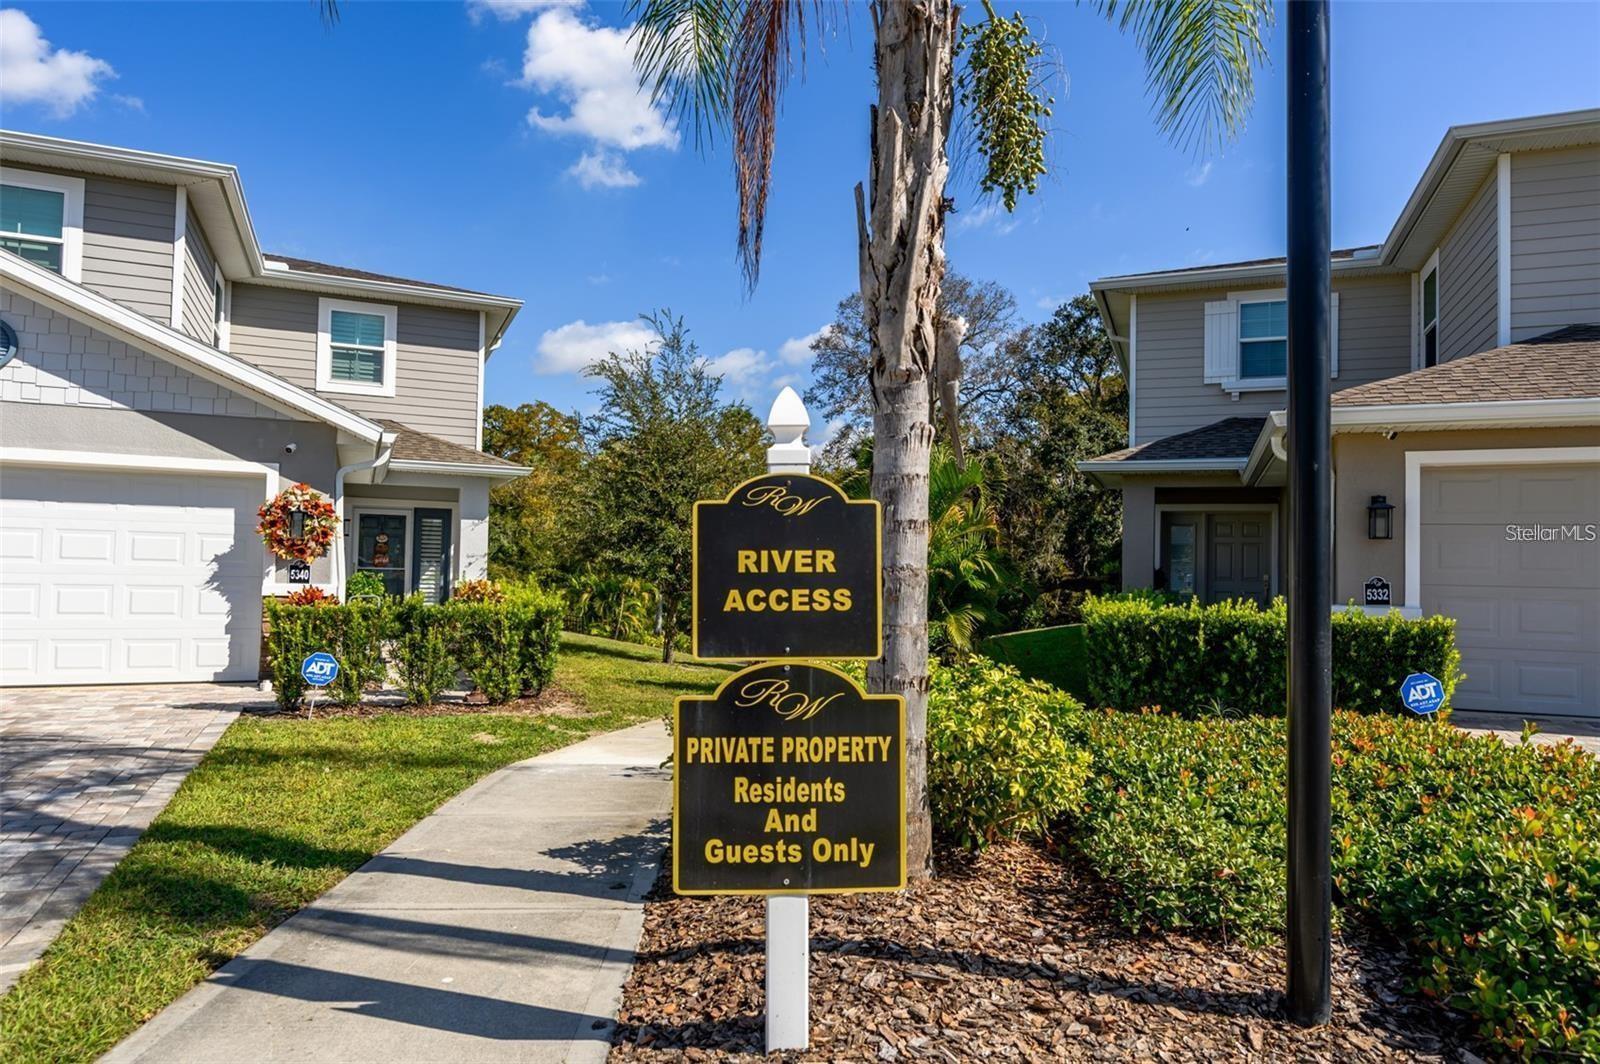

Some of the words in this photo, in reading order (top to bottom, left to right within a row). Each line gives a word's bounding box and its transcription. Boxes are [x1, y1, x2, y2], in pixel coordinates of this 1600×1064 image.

[742, 485, 832, 516] RW
[737, 549, 836, 573] RIVER
[290, 569, 309, 580] 5340
[723, 588, 852, 612] ACCESS
[1366, 588, 1389, 601] 5332
[306, 661, 336, 676] ADT
[734, 678, 845, 721] RW
[1408, 682, 1437, 703] ADT
[686, 736, 775, 763] PRIVATE
[782, 735, 892, 763] PROPERTY
[734, 776, 846, 803] Residents
[764, 808, 817, 833] And
[704, 838, 802, 864] Guests
[812, 837, 875, 868] Only
